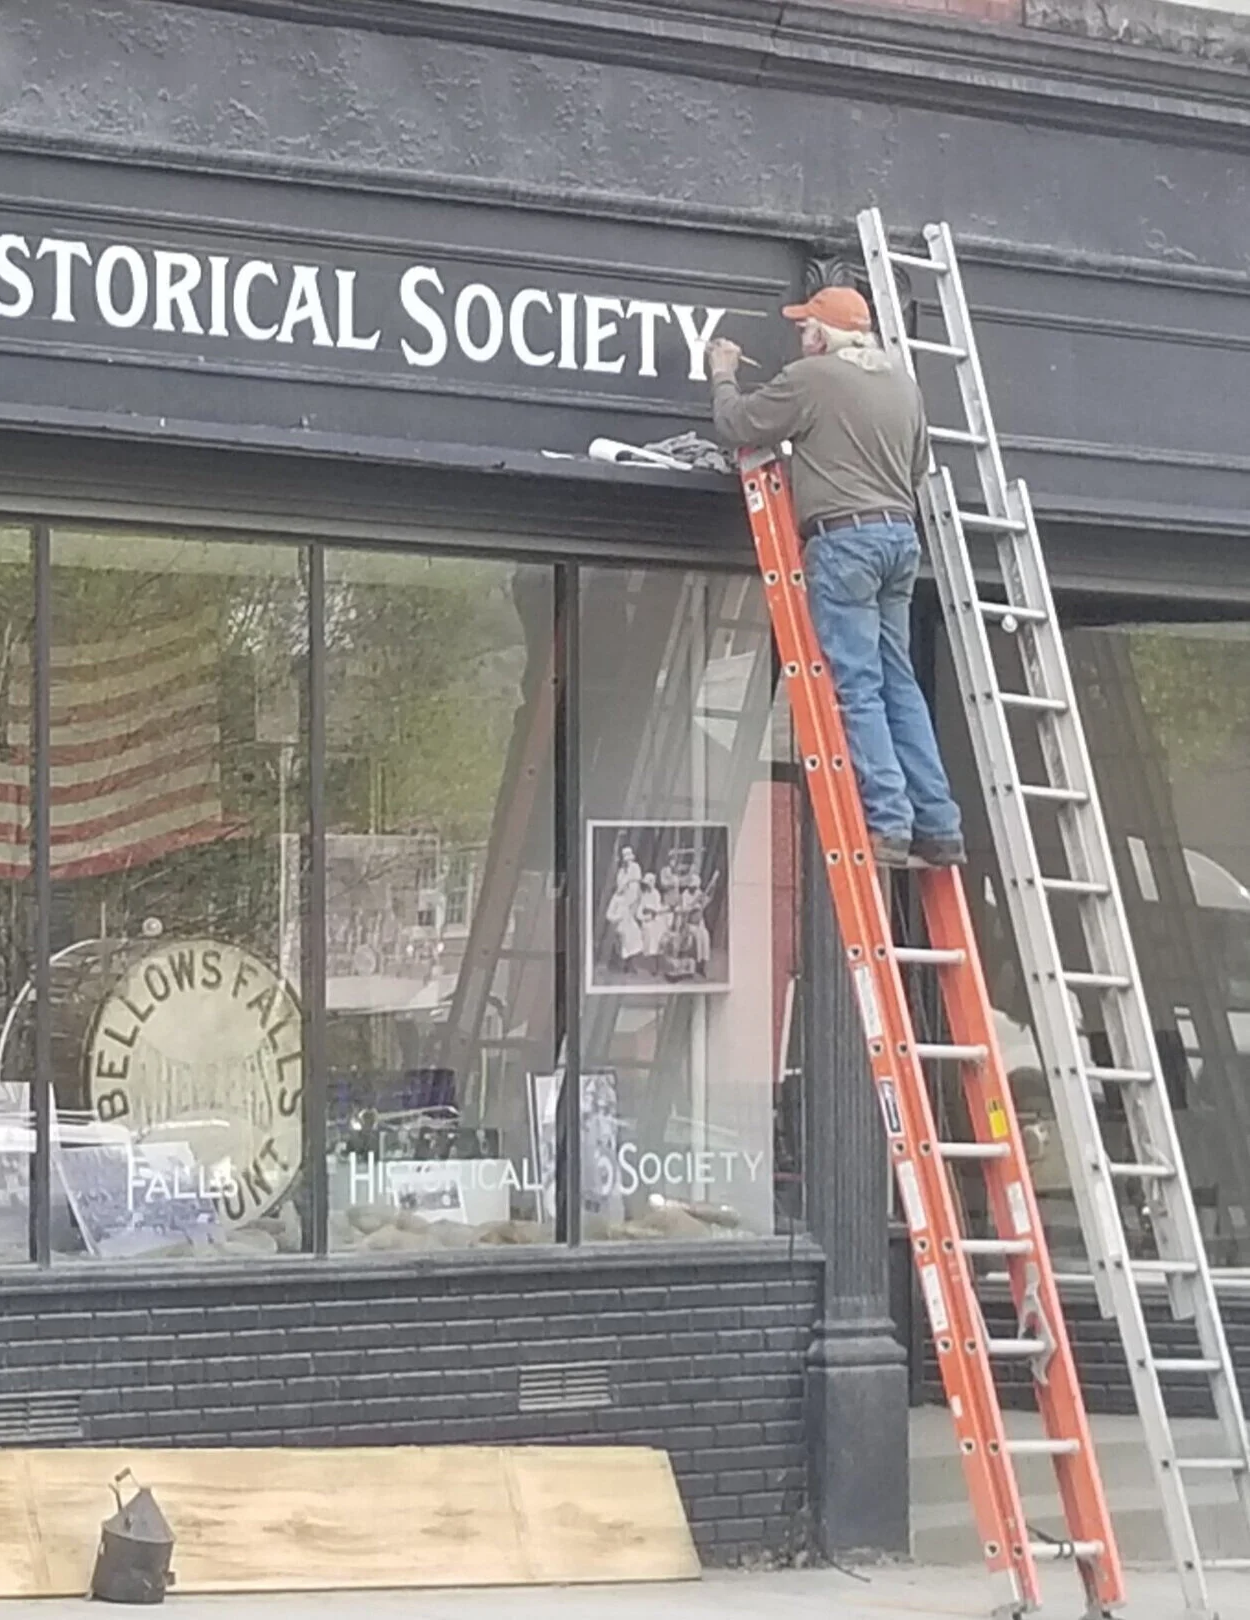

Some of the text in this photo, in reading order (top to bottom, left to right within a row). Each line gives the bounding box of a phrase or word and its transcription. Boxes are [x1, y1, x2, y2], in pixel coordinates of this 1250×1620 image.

[400, 265, 727, 381] SOCIETY
[96, 949, 302, 1123] BELLOWS FALLS
[617, 1141, 764, 1196] SOCIETY
